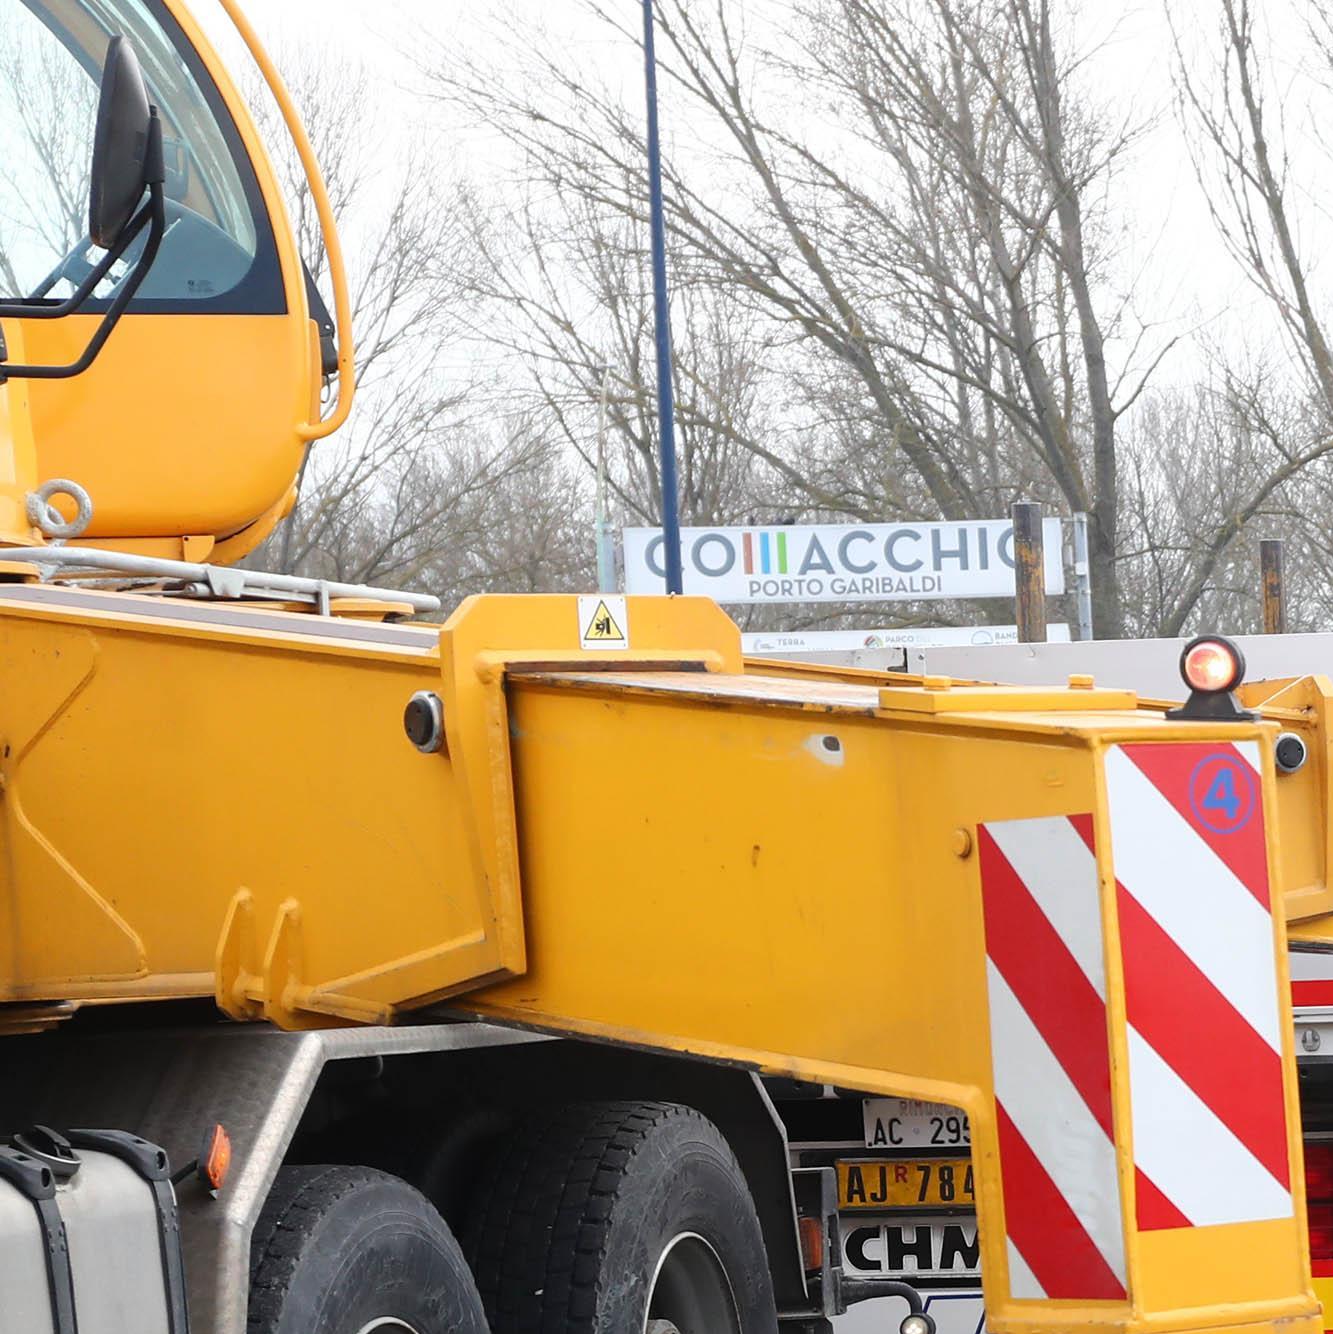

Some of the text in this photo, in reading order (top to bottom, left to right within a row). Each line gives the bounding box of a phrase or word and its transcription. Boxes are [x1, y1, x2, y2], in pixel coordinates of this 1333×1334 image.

[750, 575, 941, 597] PORTO GARIBALDI
[885, 634, 914, 643] PARCO
[1203, 767, 1242, 820] 4
[872, 1117, 904, 1146] AC
[846, 1165, 888, 1204] AJ
